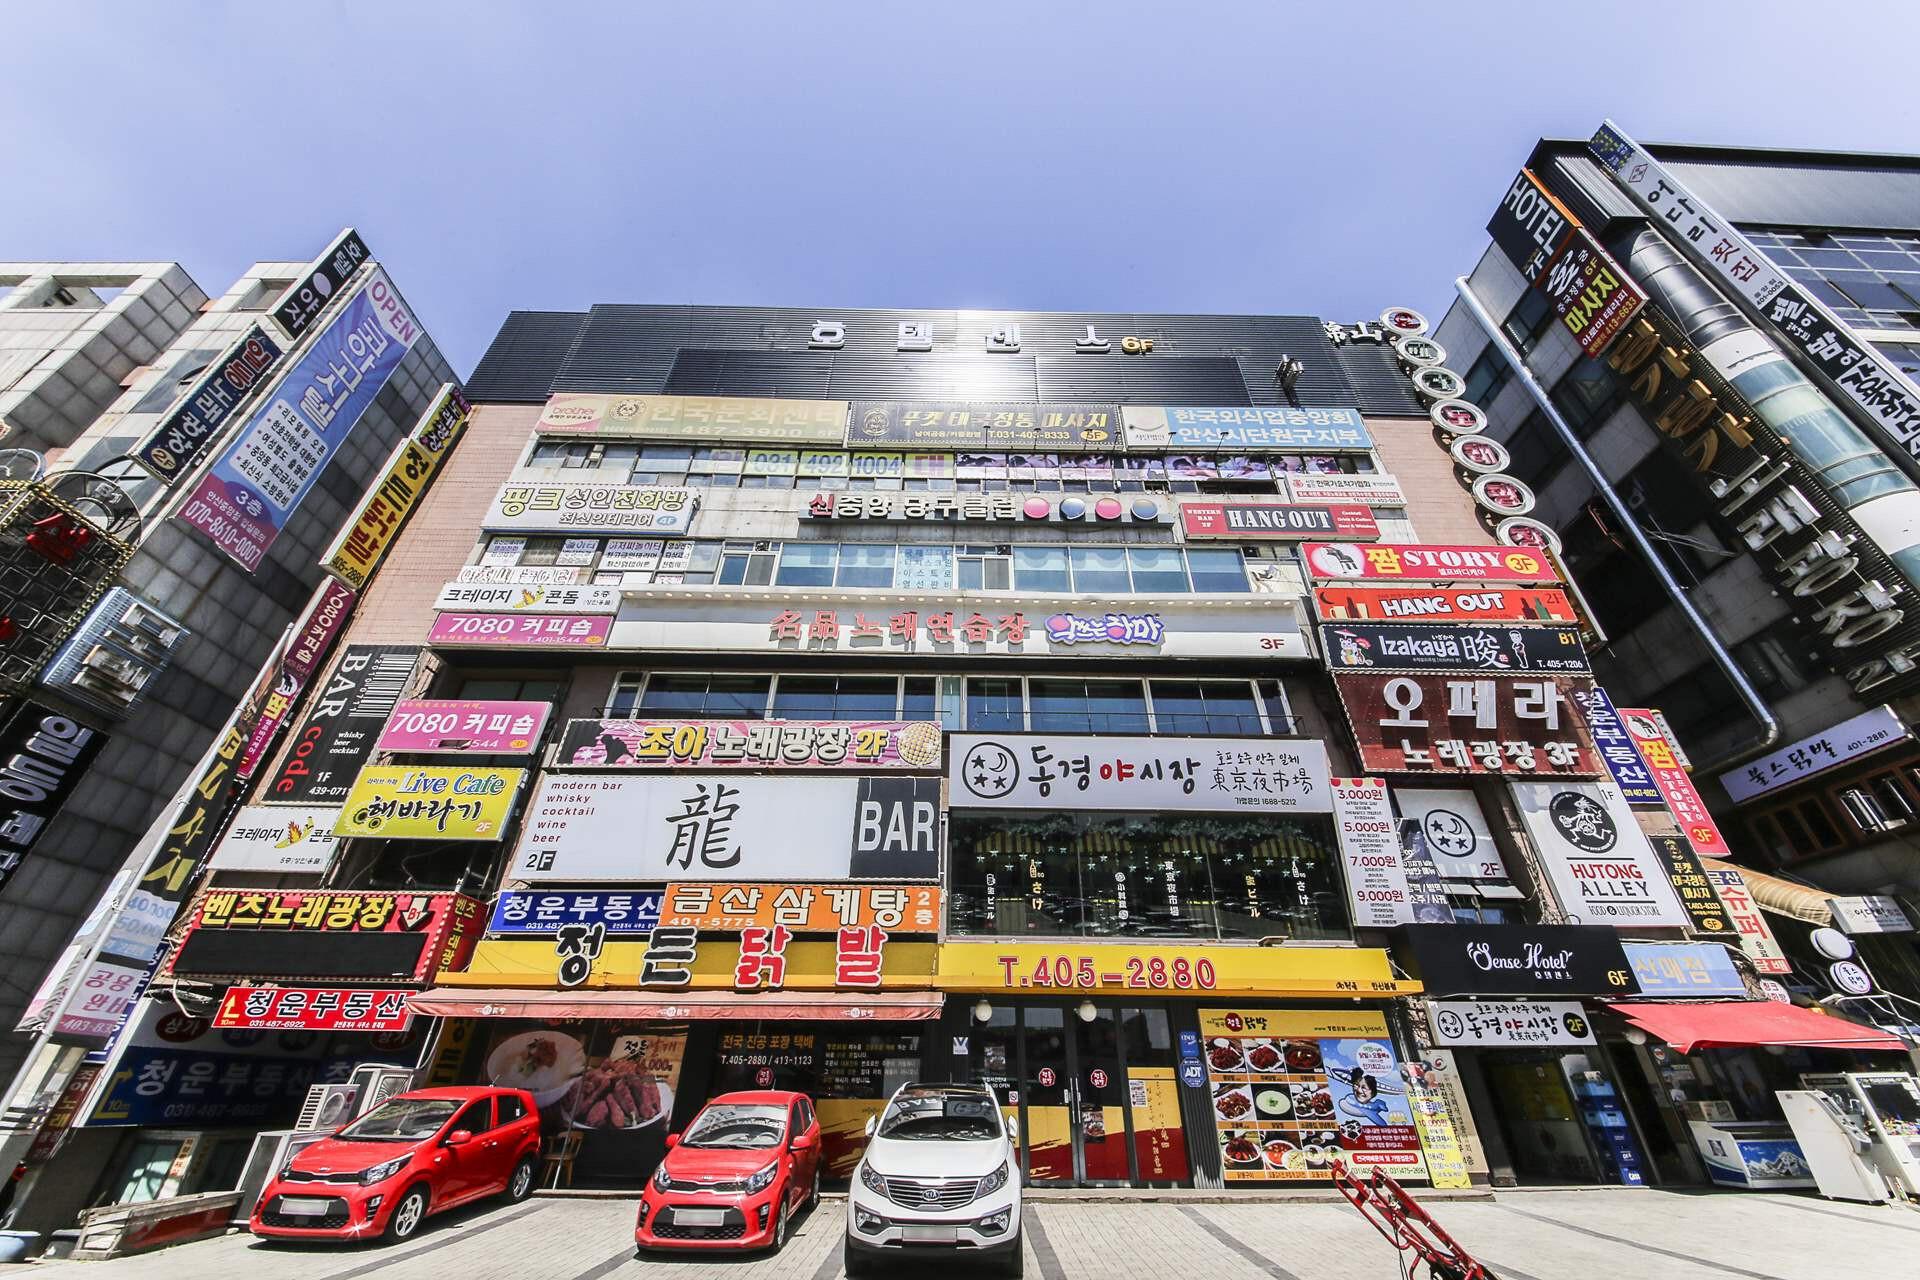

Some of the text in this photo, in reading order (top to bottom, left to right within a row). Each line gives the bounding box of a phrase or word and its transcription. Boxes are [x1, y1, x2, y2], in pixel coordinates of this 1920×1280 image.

[1504, 176, 1565, 257] HOTEL
[1526, 252, 1546, 280] 7F
[1557, 278, 1585, 313] 중국정통
[1585, 256, 1598, 276] 6F
[1757, 280, 1784, 305] 401-0053
[285, 288, 319, 329] 야자
[1564, 267, 1620, 333] 마사지
[371, 281, 416, 342] OPEN
[1582, 290, 1628, 345] 아로마 테라피
[1606, 297, 1637, 335] 413-6633
[1121, 336, 1154, 353] 6F
[1806, 331, 1861, 366] 밤에
[300, 317, 388, 431] 코아고시텔
[168, 338, 273, 455] 일등 노래광장
[1041, 413, 1108, 428] 마사지
[1175, 409, 1354, 426] 한국외식업중앙회
[1085, 431, 1101, 440] 5F
[1179, 429, 1362, 444] 안산시단원구지부
[153, 450, 175, 469] 2F
[240, 459, 264, 481] 최신식
[250, 445, 299, 494] 중앙동 최고급시설
[854, 456, 899, 475] 1004
[236, 490, 263, 516] 3층
[500, 487, 565, 516] 핑크
[904, 495, 1016, 518] 당구클럽
[659, 517, 675, 525] 4F
[1227, 510, 1330, 529] HANG OUT
[185, 500, 262, 562] 070-8610-0007
[332, 556, 365, 586] 405-2880
[1367, 548, 1533, 574] 짬 STORY 3F
[1438, 568, 1486, 577] 셀프바디케어
[443, 589, 579, 605] 크레이지 콘돔
[1380, 592, 1563, 616] HANG OUT 2F
[447, 617, 593, 635] 7080 커피숍
[769, 610, 1030, 644] 名品 노래연습장
[1260, 637, 1285, 651] 3F
[1378, 636, 1460, 658] Izakaya
[1559, 632, 1576, 645] B1
[1536, 660, 1584, 669] T. 405-1206
[311, 653, 372, 721] BAR
[1380, 677, 1566, 730] 오페라
[338, 731, 365, 739] whisky
[391, 713, 536, 735] 7080 커피숍
[635, 725, 889, 762] 조아 노래광장 2F
[1847, 730, 1889, 753] 401-2881
[277, 726, 323, 792] code
[1216, 751, 1300, 766] 호프 소주 안주 일체
[1402, 739, 1580, 770] 노래광장 3F
[1640, 741, 1676, 769] 짬
[316, 772, 332, 783] 1F
[1029, 745, 1201, 798] 동경야시장
[1210, 767, 1313, 796] 東京夜市場
[397, 771, 507, 795] Live Cafe
[551, 781, 624, 790] modern bar
[1601, 788, 1615, 800] 1F
[547, 793, 592, 804] whisky
[1262, 798, 1297, 806] 1688-5212
[1338, 790, 1383, 800] 3,000원
[1660, 771, 1695, 823] STORY
[368, 796, 482, 832] 해바라기
[541, 807, 595, 816] cocktail
[232, 828, 284, 842] 크레이지
[475, 822, 492, 833] 2F
[537, 820, 567, 829] wine
[665, 783, 742, 872] 龍
[857, 800, 936, 852] BAR
[1344, 822, 1390, 833] 5,000원
[532, 833, 561, 842] beer
[1693, 829, 1713, 843] 3F
[525, 850, 557, 871] 2F
[1350, 856, 1397, 867] 7,000원
[1481, 863, 1500, 876] 2F
[1570, 864, 1642, 879] HUTONG
[1164, 861, 1180, 917] 東京夜市場
[1581, 881, 1649, 897] ALLEY
[1708, 872, 1741, 885] 금산
[1032, 882, 1044, 911] さけ
[1297, 881, 1309, 906] さけ
[1357, 890, 1404, 903] 9,000원
[1683, 888, 1710, 898] 마사지
[201, 893, 394, 928] 벤츠노래광장
[407, 907, 423, 920] B1
[454, 898, 477, 919] 벤츠
[672, 887, 909, 927] 금산삼계탕
[914, 890, 935, 925] 2층
[1590, 906, 1661, 916] FOOD LIQUOR STORE
[1720, 886, 1766, 939] 슈퍼
[670, 916, 756, 927] 401-5775
[1707, 920, 1718, 929] 5F
[555, 920, 888, 989] 정든닭발
[1467, 942, 1573, 971] Sense Hotel
[997, 955, 1218, 990] T.405-2880
[1607, 970, 1630, 985] 6F
[245, 992, 406, 1020] 청운부동산
[1476, 1004, 1493, 1015] 호프
[1495, 1005, 1510, 1013] 소주
[1512, 1005, 1529, 1014] 안주
[1244, 1016, 1268, 1031] 닭발
[1465, 1012, 1584, 1039] 동경야시장 2F
[722, 1035, 744, 1049] 전국
[721, 1056, 812, 1065] T.405-2880 413-1123
[1184, 1068, 1202, 1079] ADT
